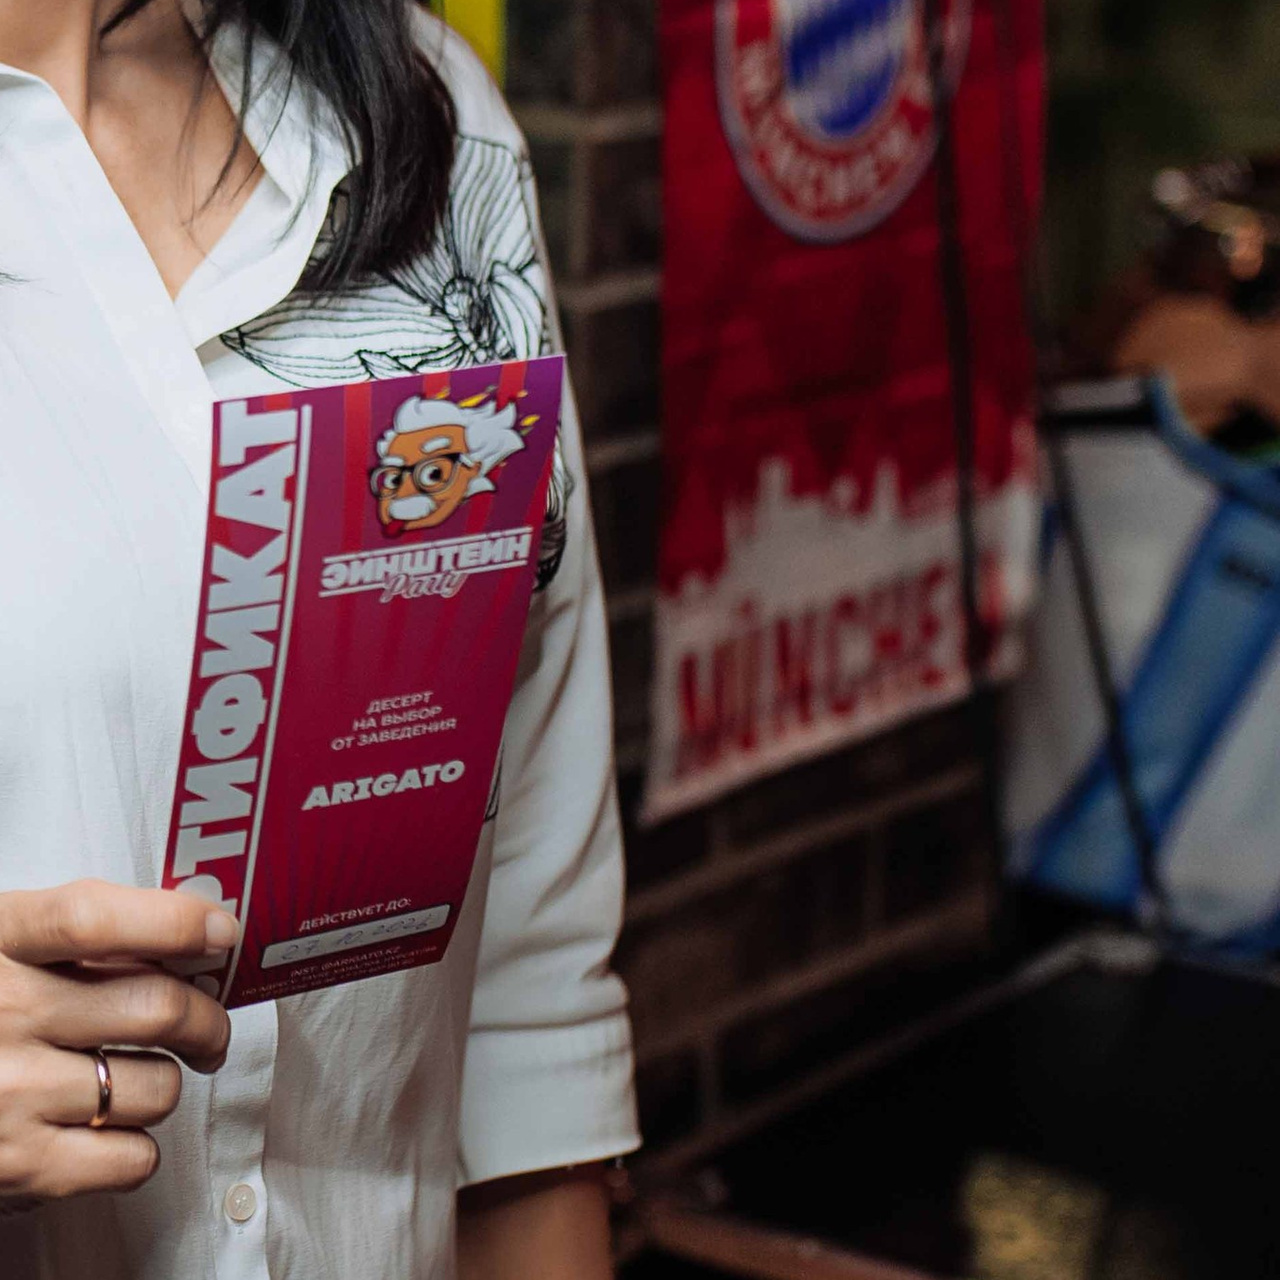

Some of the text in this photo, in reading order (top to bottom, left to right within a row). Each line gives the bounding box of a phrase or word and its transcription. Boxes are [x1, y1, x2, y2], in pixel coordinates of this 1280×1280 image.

[366, 690, 434, 715] ДЕСЕРТ
[352, 705, 443, 732] НА ВЫБОР
[331, 718, 458, 751] ОТ ЗАВЕДЕНИЯ
[300, 759, 466, 811] ARIGATO
[299, 903, 384, 932] ДЕЙСТВУЕТ
